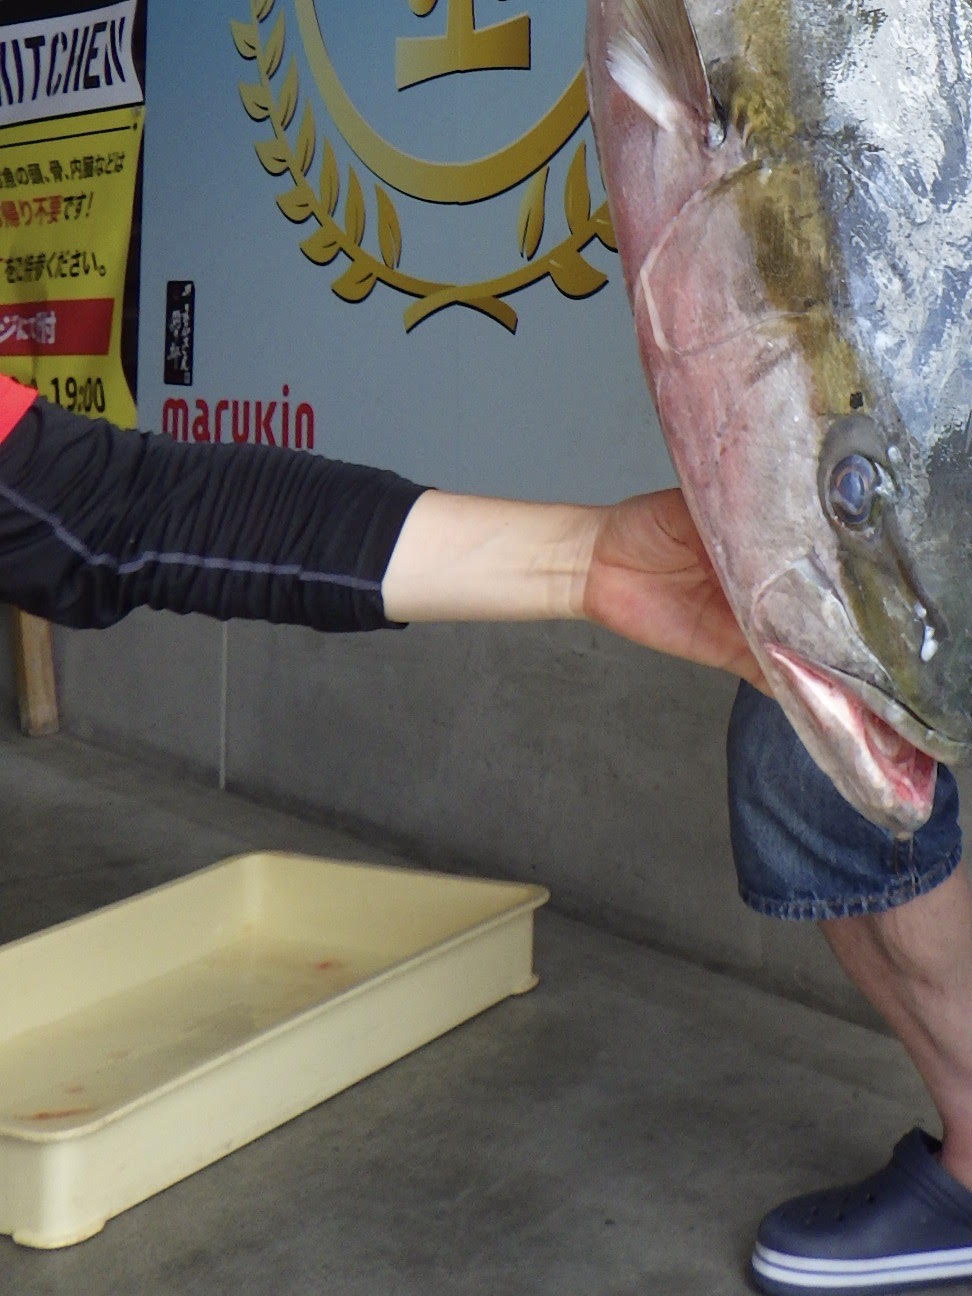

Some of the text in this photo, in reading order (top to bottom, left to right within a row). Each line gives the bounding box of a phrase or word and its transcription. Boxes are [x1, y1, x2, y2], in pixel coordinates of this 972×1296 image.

[0, 191, 94, 228] 帰り不要です!
[50, 377, 106, 415] 19:00
[162, 383, 315, 450] marukin
